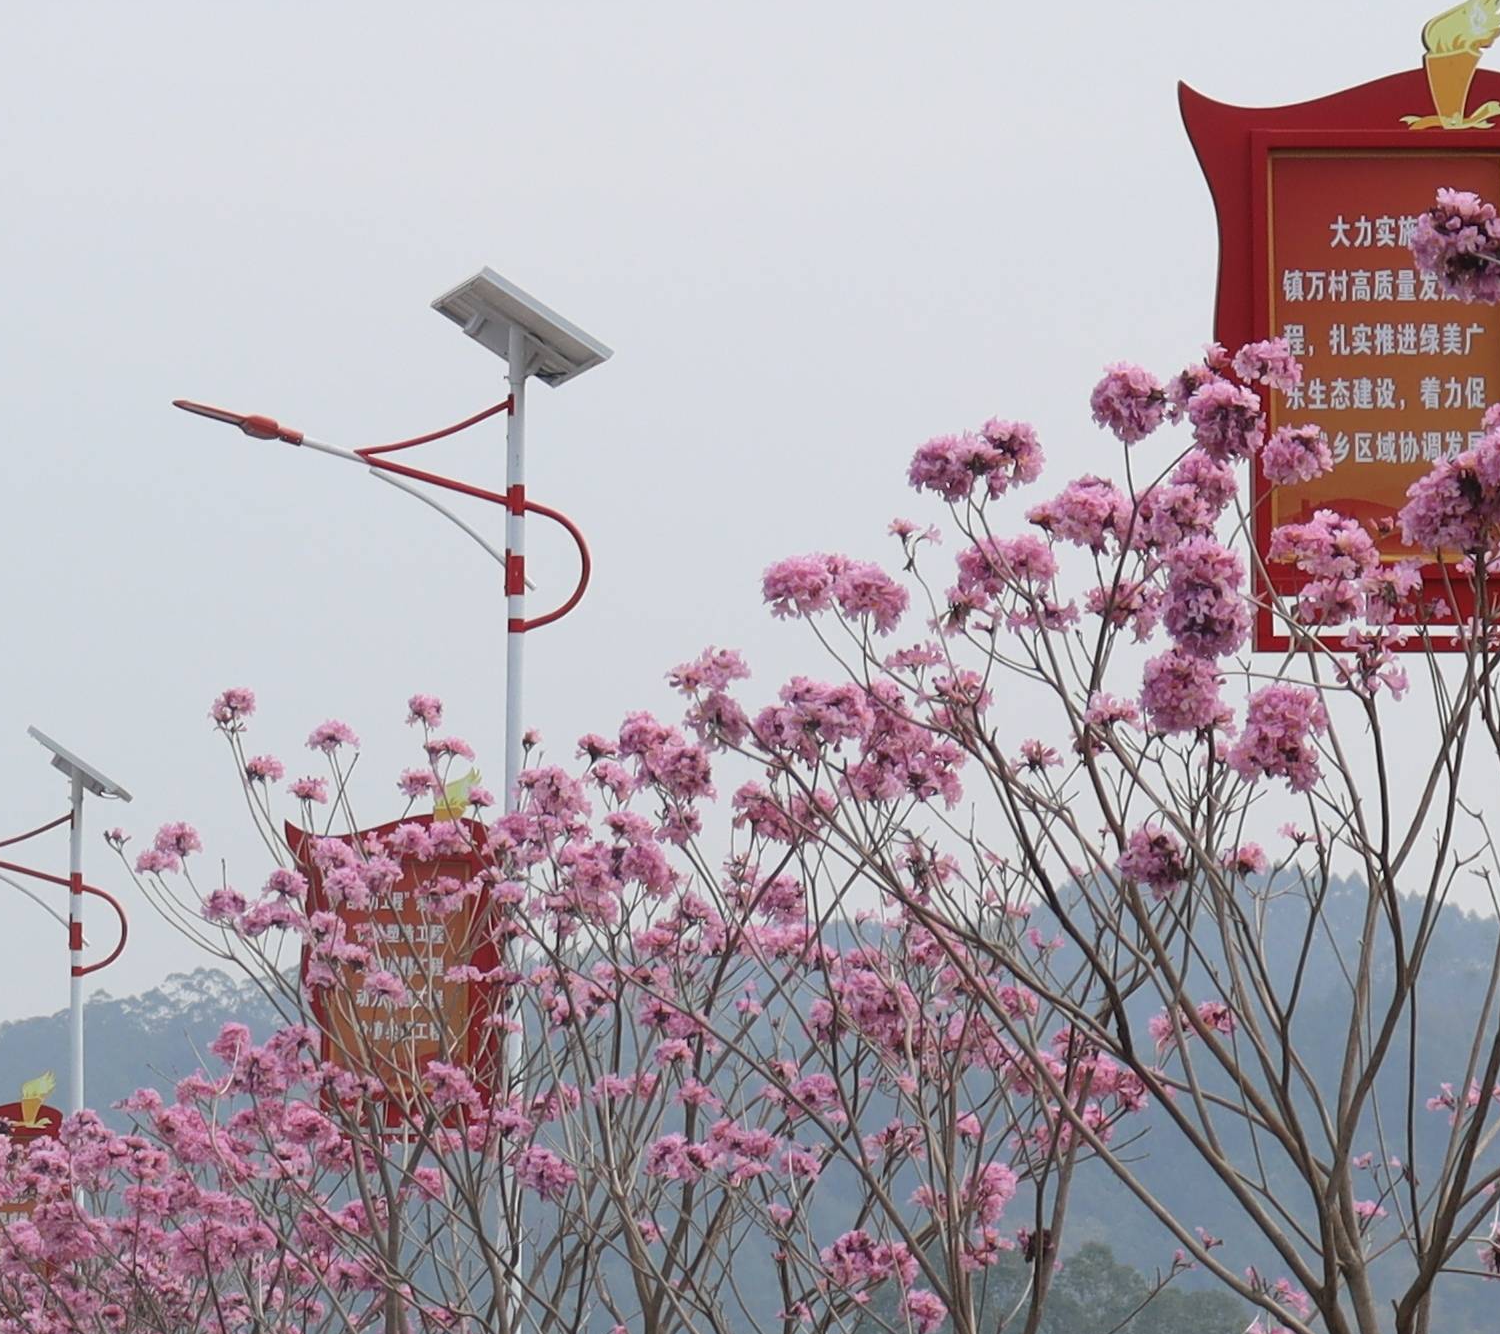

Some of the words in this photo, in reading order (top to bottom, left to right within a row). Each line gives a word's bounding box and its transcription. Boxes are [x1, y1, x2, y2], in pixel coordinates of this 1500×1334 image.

[1283, 269, 1462, 303] 镇万村高质量发
[1283, 323, 1485, 357] 程，扎实推进绿美广
